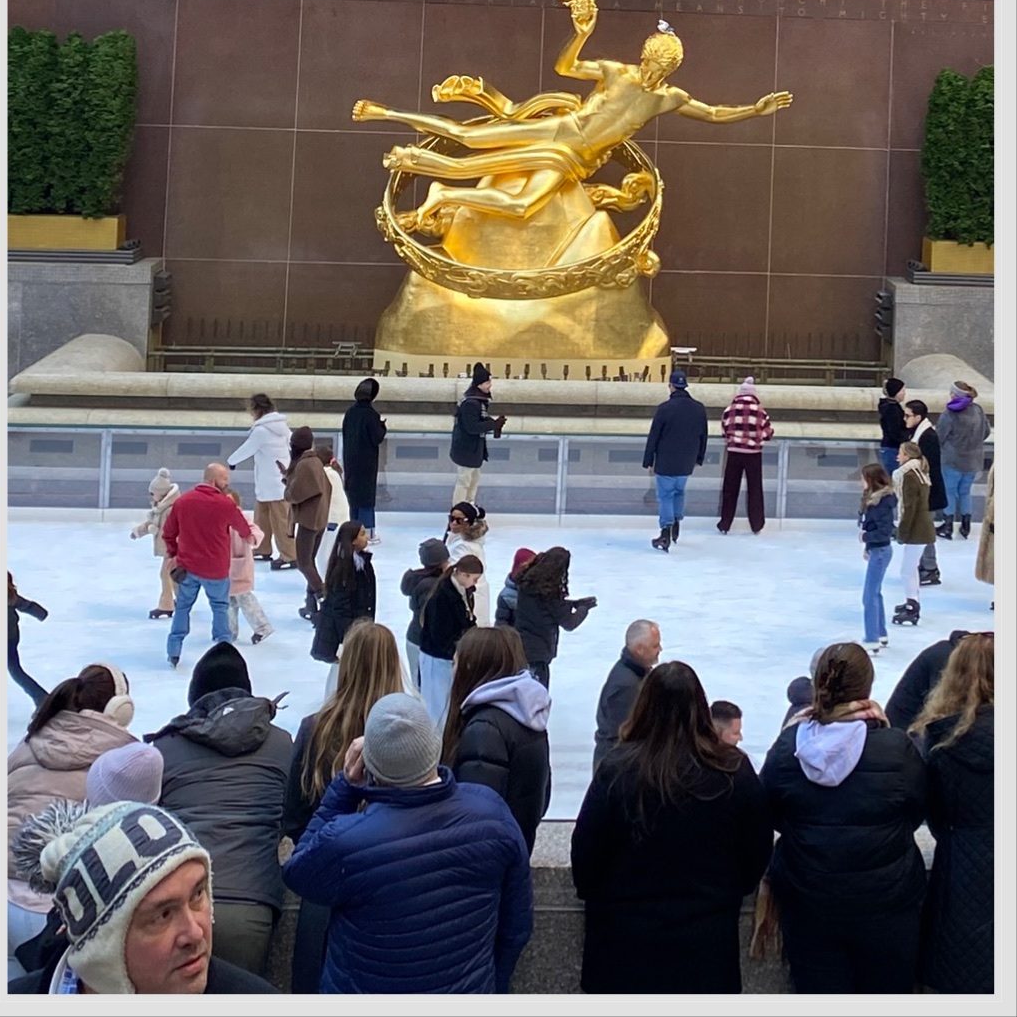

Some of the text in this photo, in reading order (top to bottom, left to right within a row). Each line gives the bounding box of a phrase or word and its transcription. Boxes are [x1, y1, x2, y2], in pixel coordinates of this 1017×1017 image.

[654, 2, 744, 15] MEANS
[779, 6, 807, 17] TO
[838, 9, 948, 21] MIGHTY
